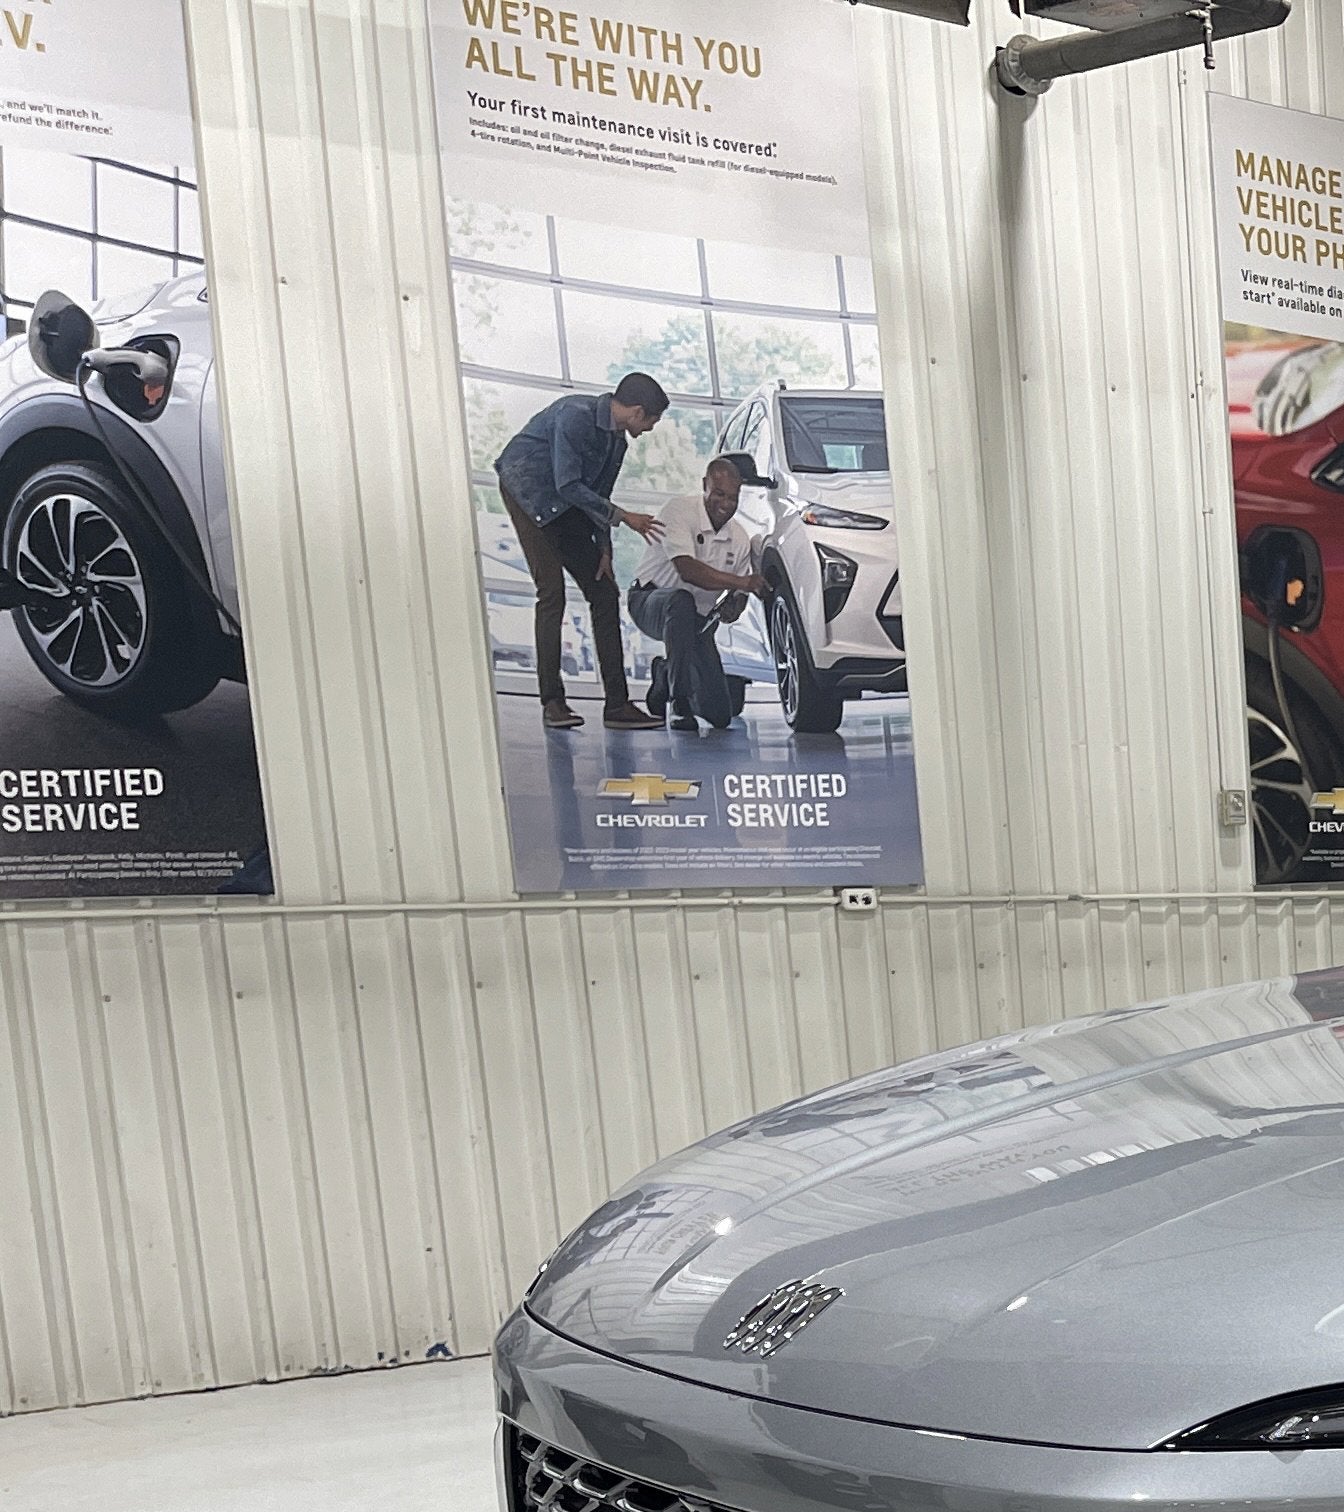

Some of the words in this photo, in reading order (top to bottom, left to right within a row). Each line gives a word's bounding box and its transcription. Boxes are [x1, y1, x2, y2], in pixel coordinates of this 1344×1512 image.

[0, 10, 46, 53] V.
[463, 0, 578, 46] WE'RE
[590, 17, 683, 66] WITH
[693, 36, 762, 78] YOU
[465, 37, 536, 82] ALL
[546, 52, 617, 96] THE
[627, 67, 712, 113] WAY.
[7, 101, 26, 110] and
[56, 107, 89, 119] match
[35, 117, 52, 127] the
[467, 91, 505, 113] Your
[511, 99, 547, 120] first
[552, 110, 655, 139] maintenance
[658, 126, 692, 146] visit
[696, 131, 709, 148] is
[1235, 149, 1343, 199] MANAGE
[1236, 186, 1344, 235] VEHICLE
[1238, 223, 1308, 264] YOUR
[1241, 268, 1269, 287] View
[1271, 276, 1325, 297] real-time
[1277, 294, 1327, 316] available
[1328, 306, 1343, 318] on
[0, 768, 164, 797] CERTIFIED
[723, 773, 847, 799] CERTIFIED
[2, 803, 140, 832] SERVICE
[595, 814, 709, 828] CHEVROLET
[726, 803, 830, 828] SERVICE
